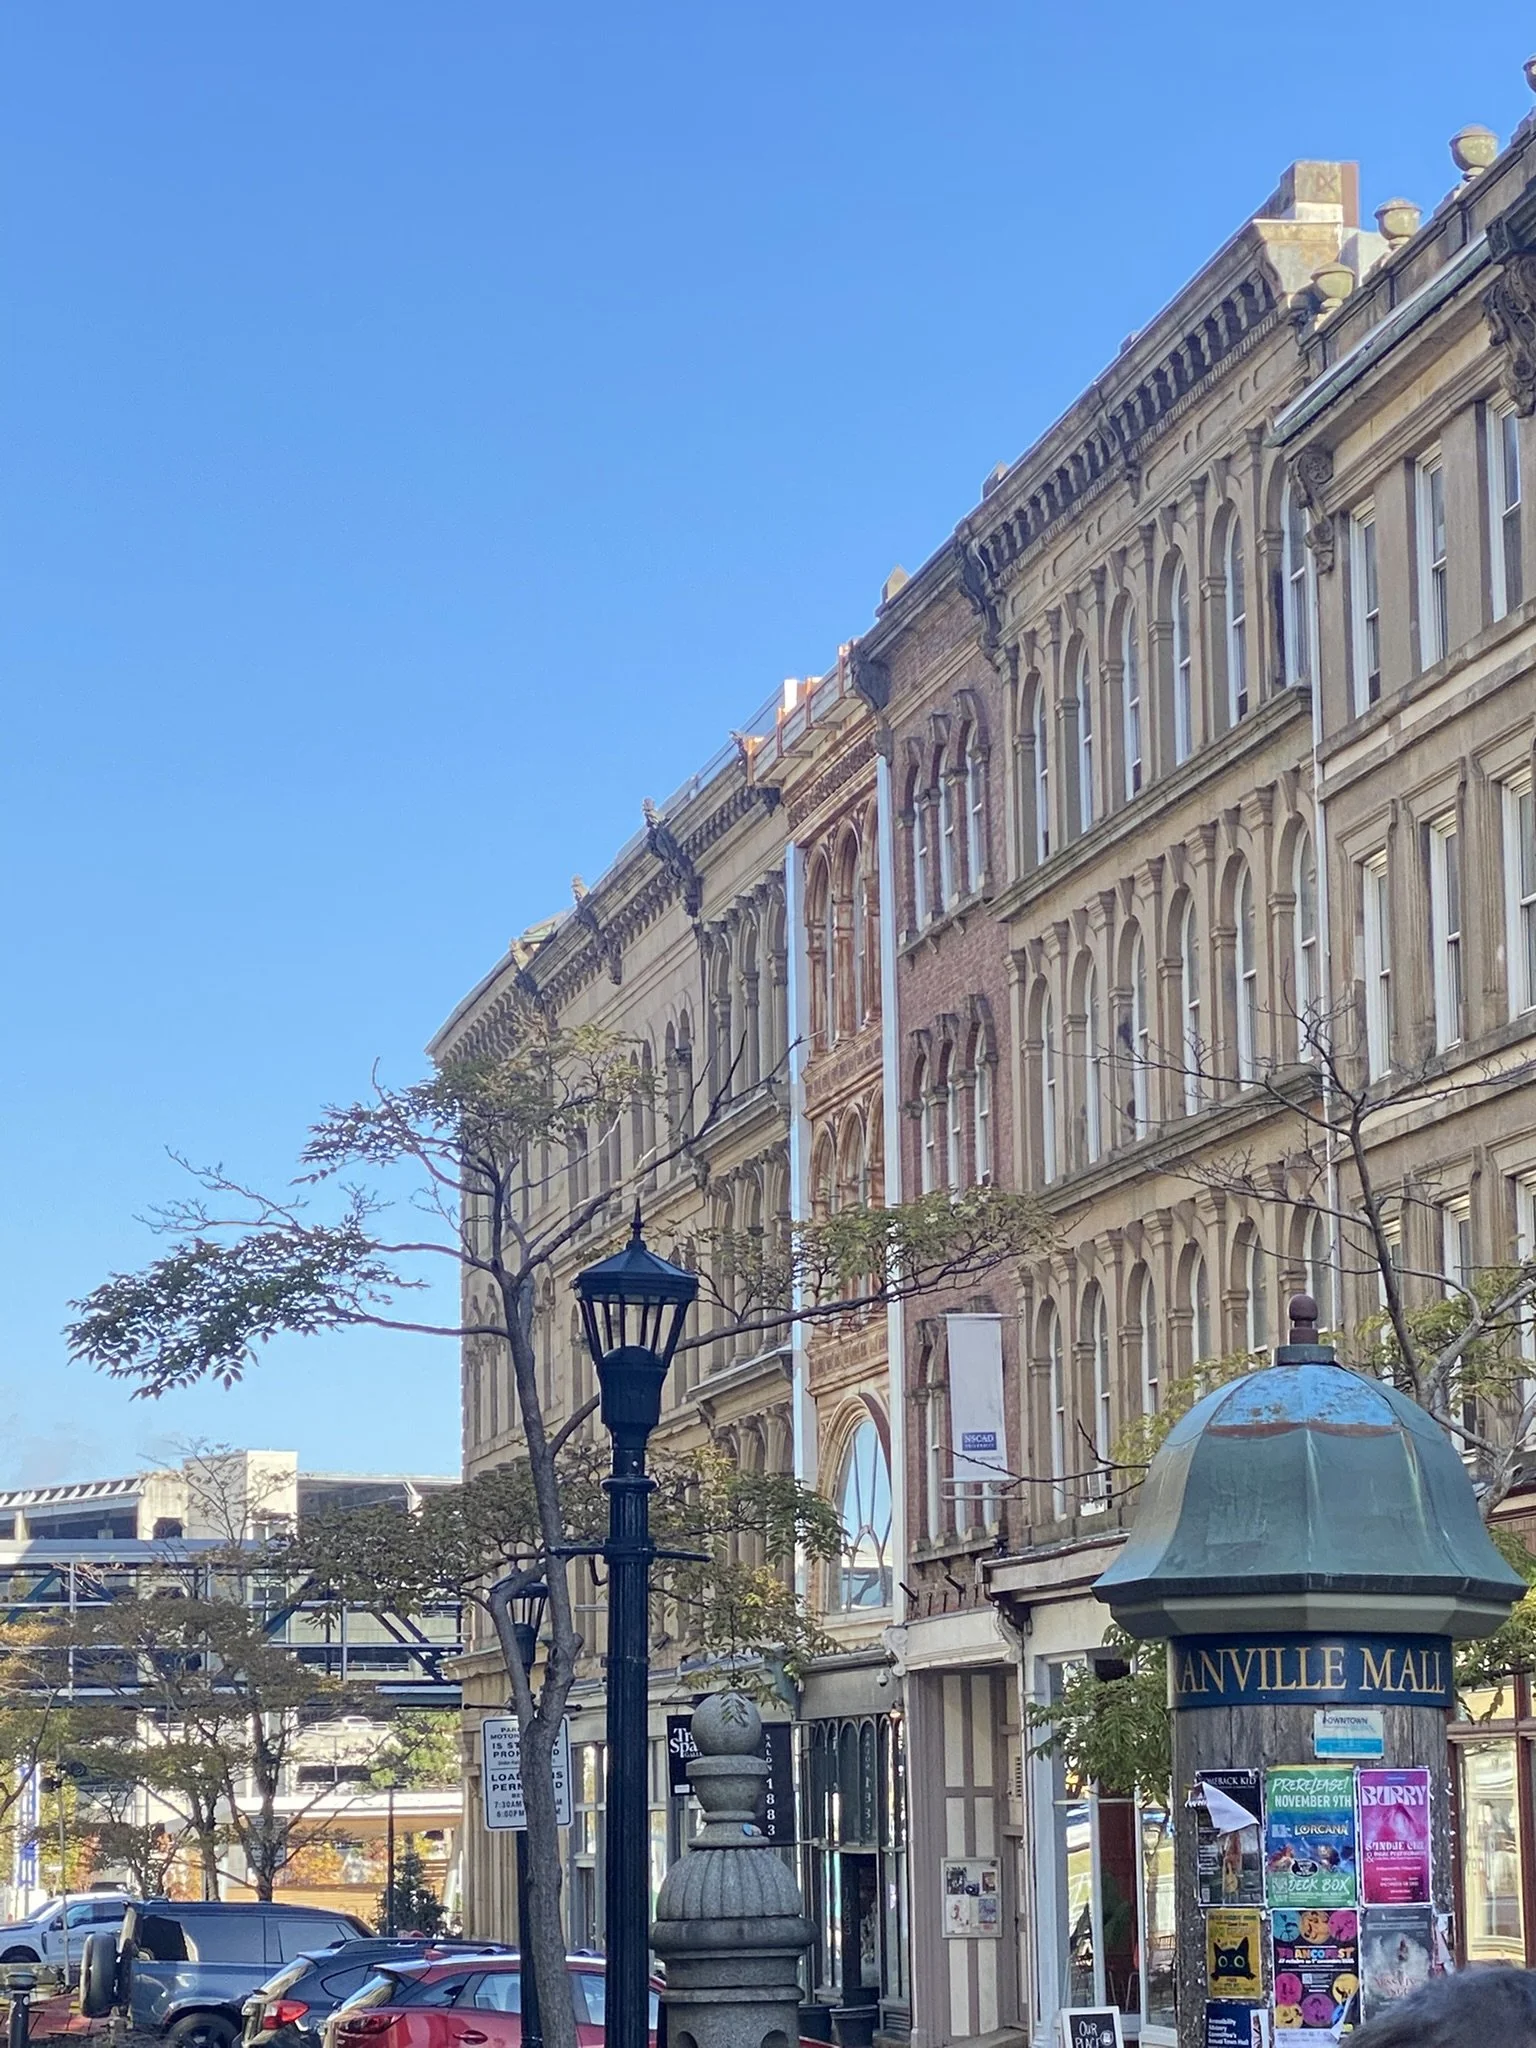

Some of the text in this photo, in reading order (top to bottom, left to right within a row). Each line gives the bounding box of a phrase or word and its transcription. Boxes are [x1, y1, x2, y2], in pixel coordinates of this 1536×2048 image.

[964, 1434, 994, 1443] NSCAD
[1174, 1647, 1446, 1694] ANVILLE MALL
[1240, 1776, 1256, 1785] KID
[766, 1777, 776, 1836] 1883
[1274, 1795, 1352, 1807] NOVEMBER 9TH
[1294, 1824, 1349, 1836] LORCANA
[1288, 1876, 1351, 1895] DECK BOX
[1079, 2020, 1099, 2037] OUR
